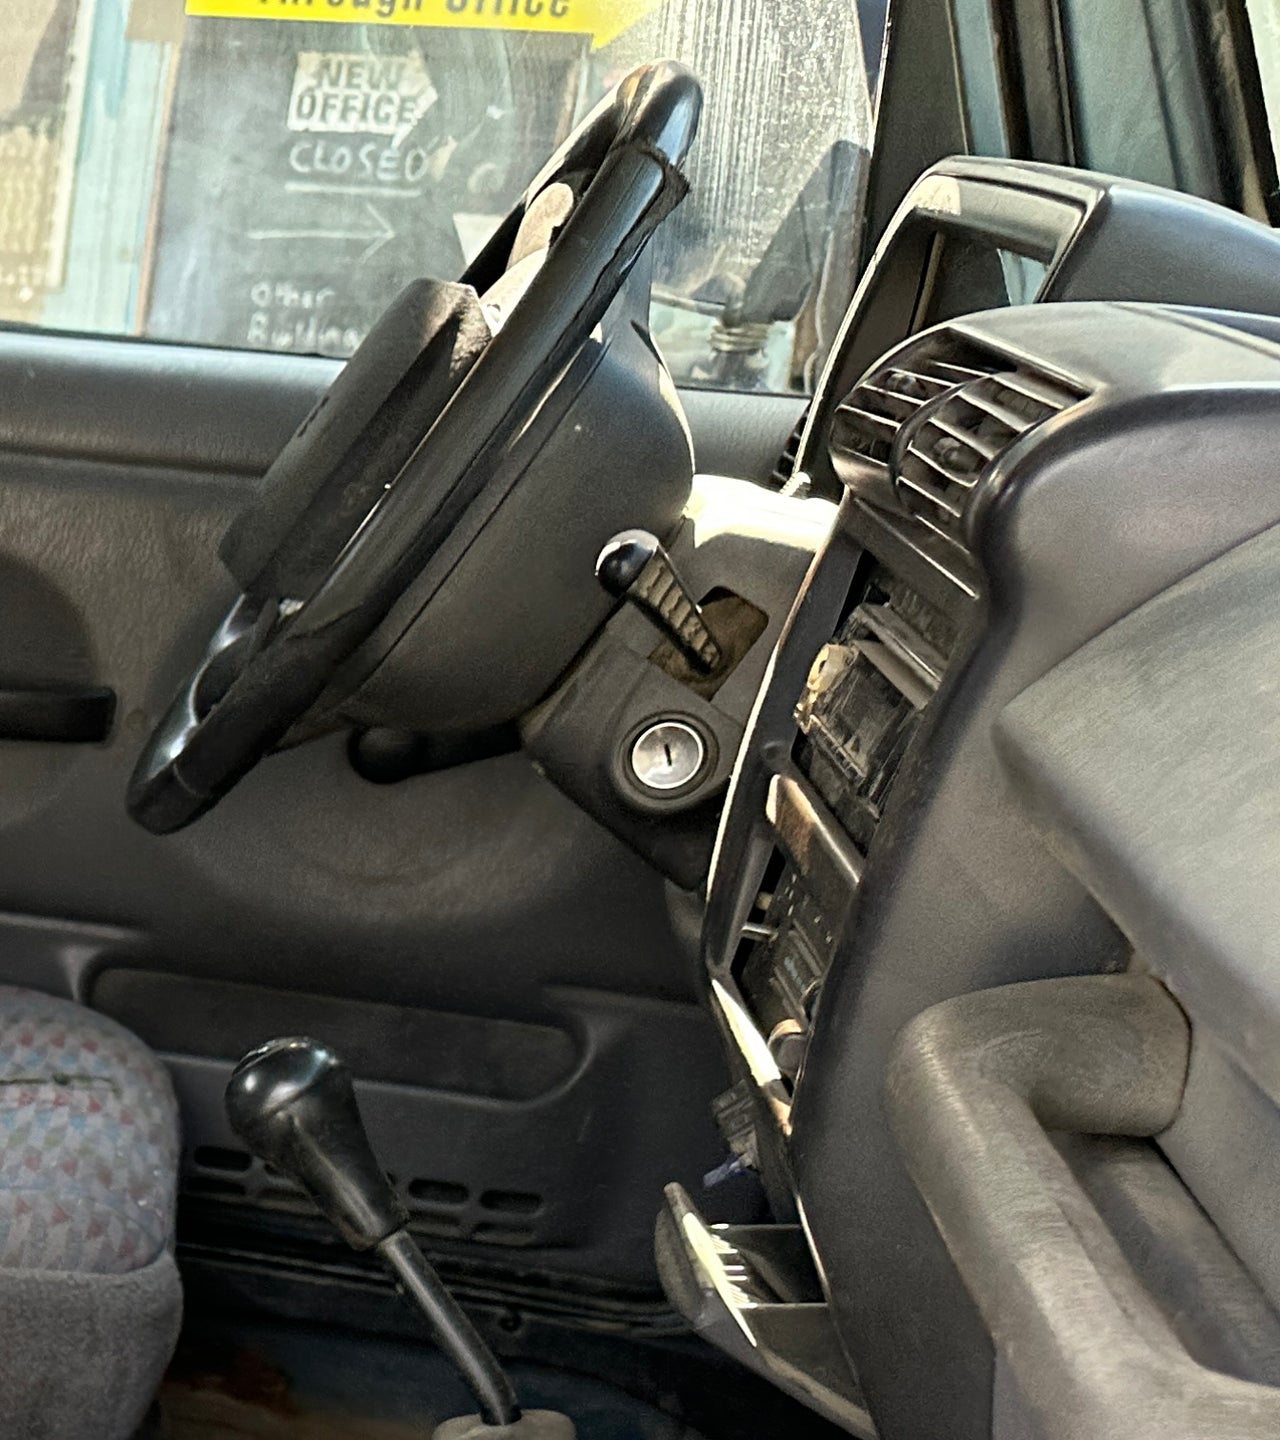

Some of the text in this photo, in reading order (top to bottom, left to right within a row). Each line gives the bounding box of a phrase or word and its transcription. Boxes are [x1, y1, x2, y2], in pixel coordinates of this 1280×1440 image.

[444, 0, 569, 18] ice
[317, 57, 404, 88] NEW
[296, 88, 418, 124] OFFICE
